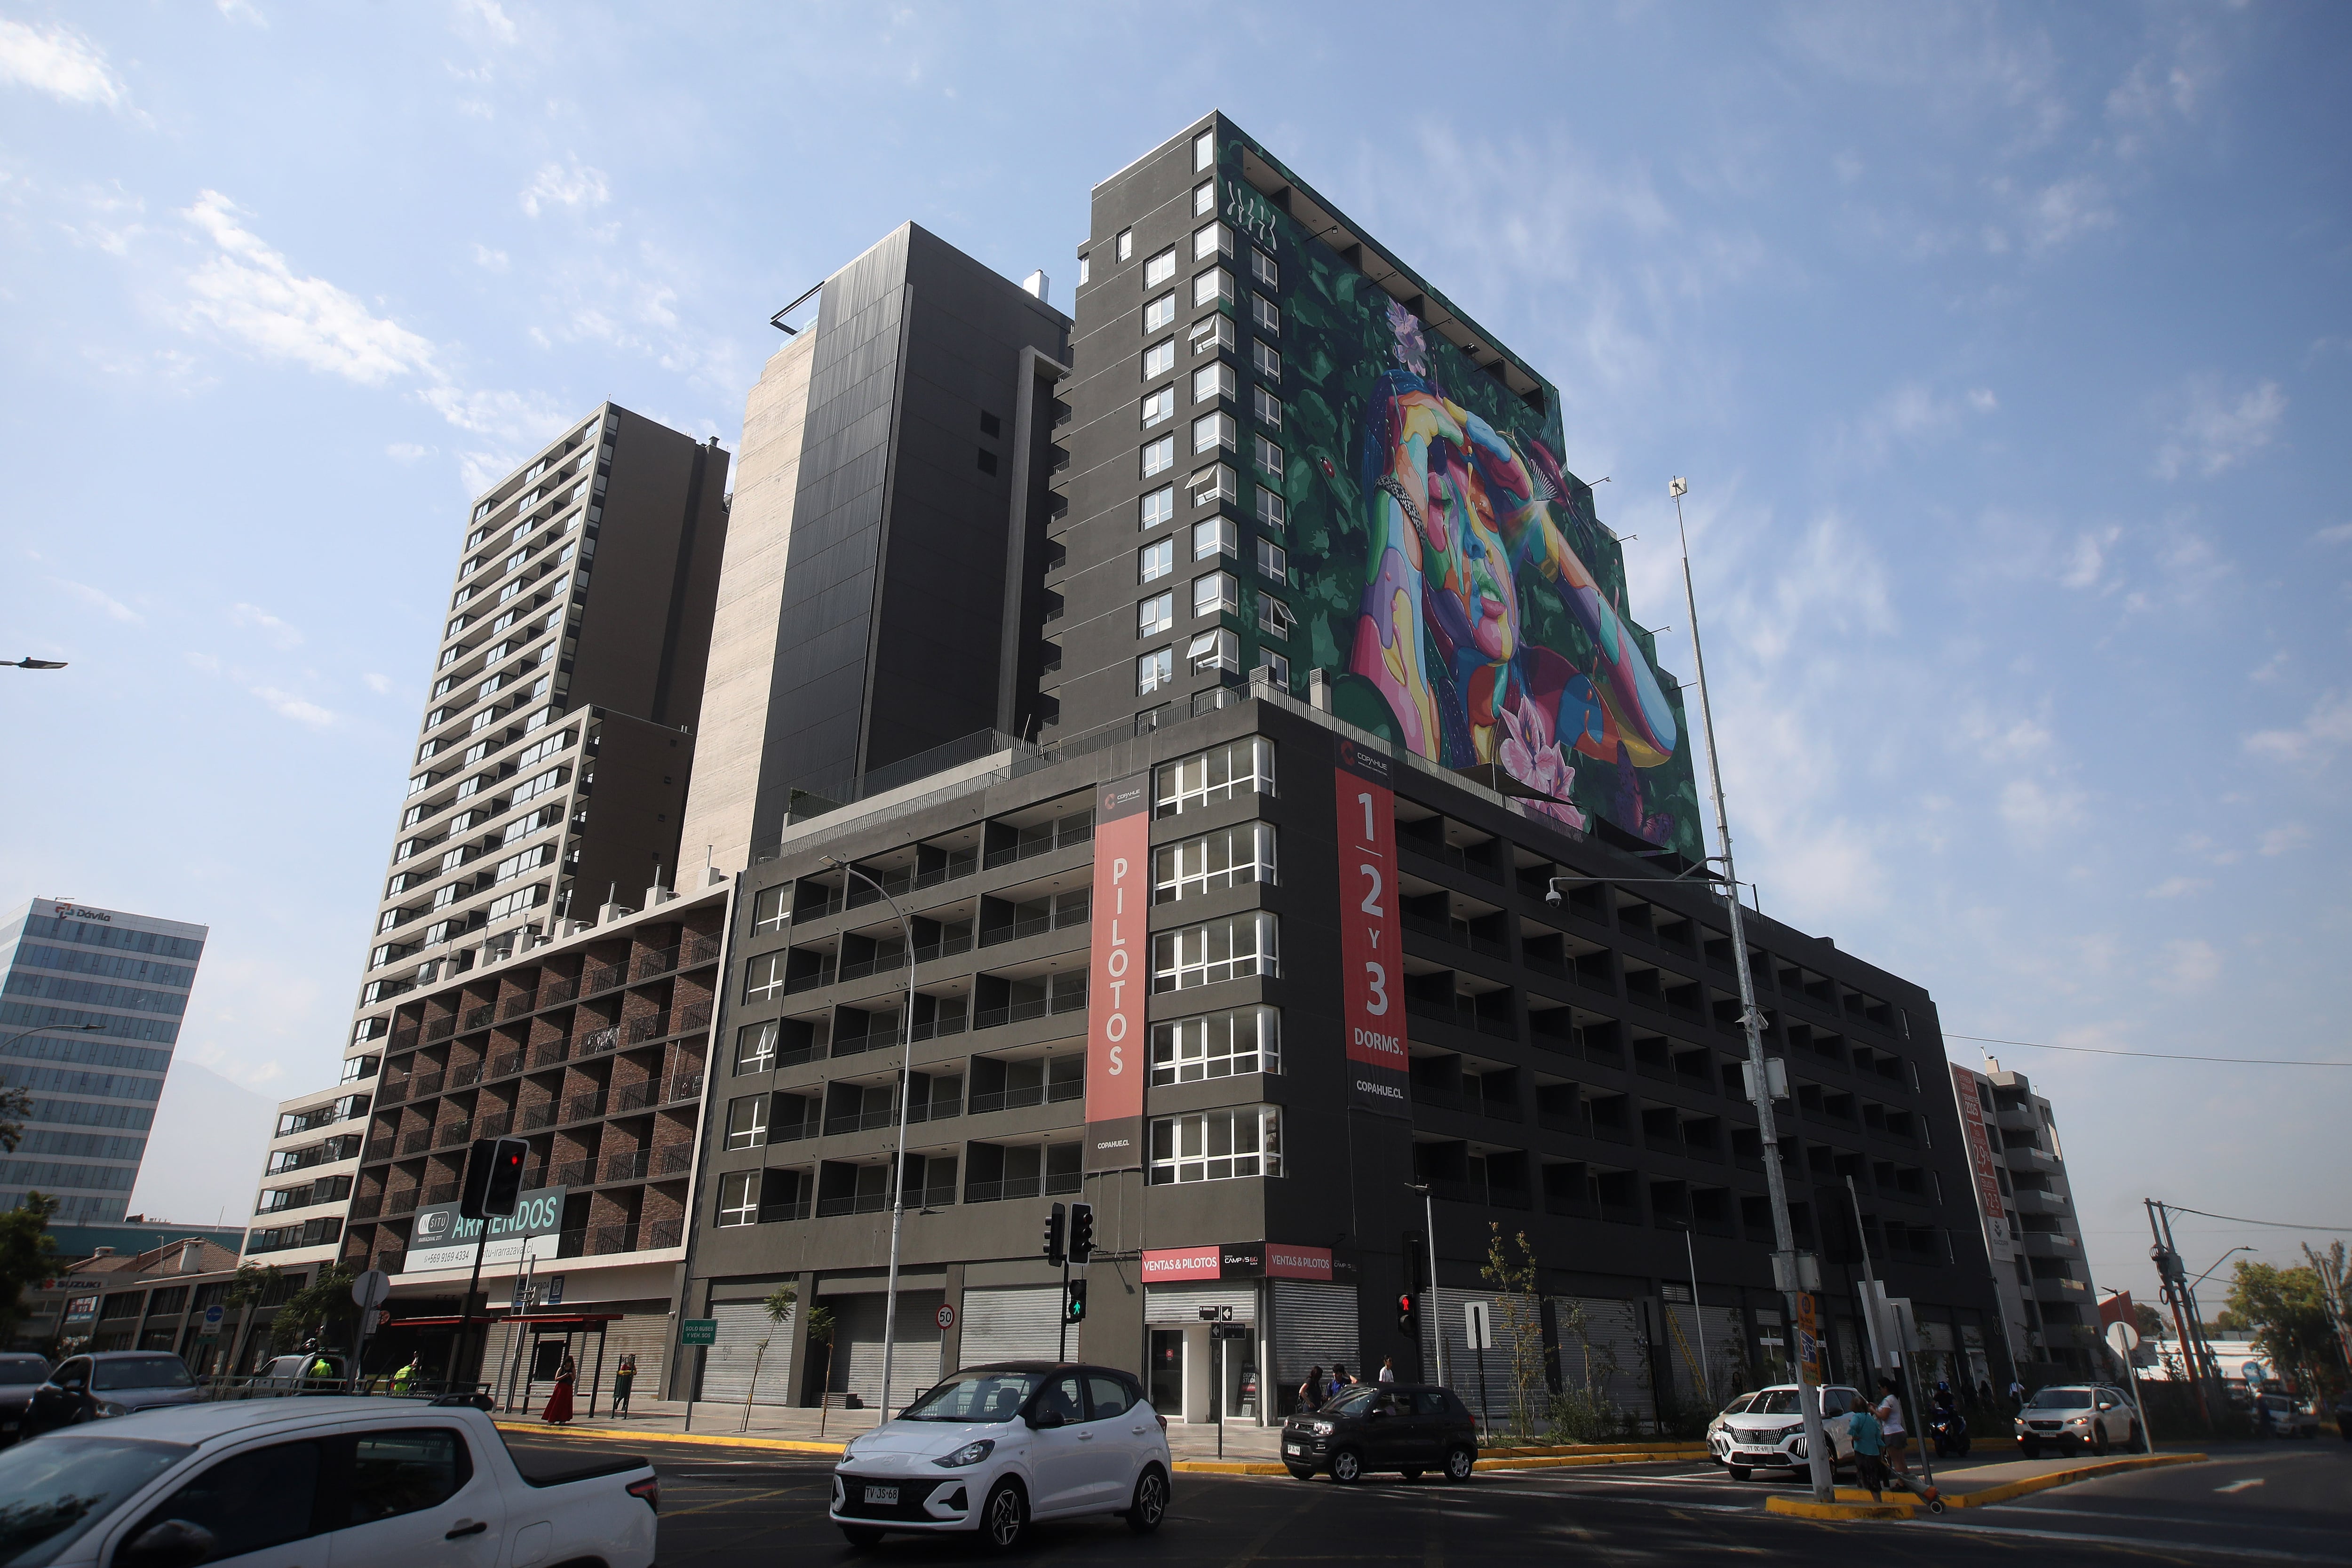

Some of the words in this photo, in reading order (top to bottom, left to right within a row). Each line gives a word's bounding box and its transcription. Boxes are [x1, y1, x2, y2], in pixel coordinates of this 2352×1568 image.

[1357, 753, 1387, 770] COPAHUE
[1117, 788, 1140, 800] COPAHUE
[1358, 793, 1374, 841] 1
[1360, 864, 1383, 918] 2
[77, 908, 111, 922] Dávila
[1368, 927, 1380, 948] Y
[1106, 858, 1128, 1075] PILOTOS
[1366, 962, 1388, 1016] 3
[1354, 1027, 1403, 1055] DORMS.
[1357, 1080, 1404, 1099] COPAHUE.CL
[1097, 1139, 1129, 1149] COPAHUE.CL
[430, 1217, 446, 1228] SITU
[427, 1253, 440, 1264] +569
[441, 1252, 454, 1262] 9169
[455, 1250, 469, 1260] 4334
[1144, 1259, 1174, 1271] VENTAS
[1175, 1259, 1182, 1269] &
[1183, 1257, 1217, 1270] PILOTOS
[1271, 1255, 1296, 1266] VENTAS
[1297, 1257, 1303, 1267] &
[1303, 1258, 1330, 1269] PILOTOS
[939, 1311, 952, 1322] 50
